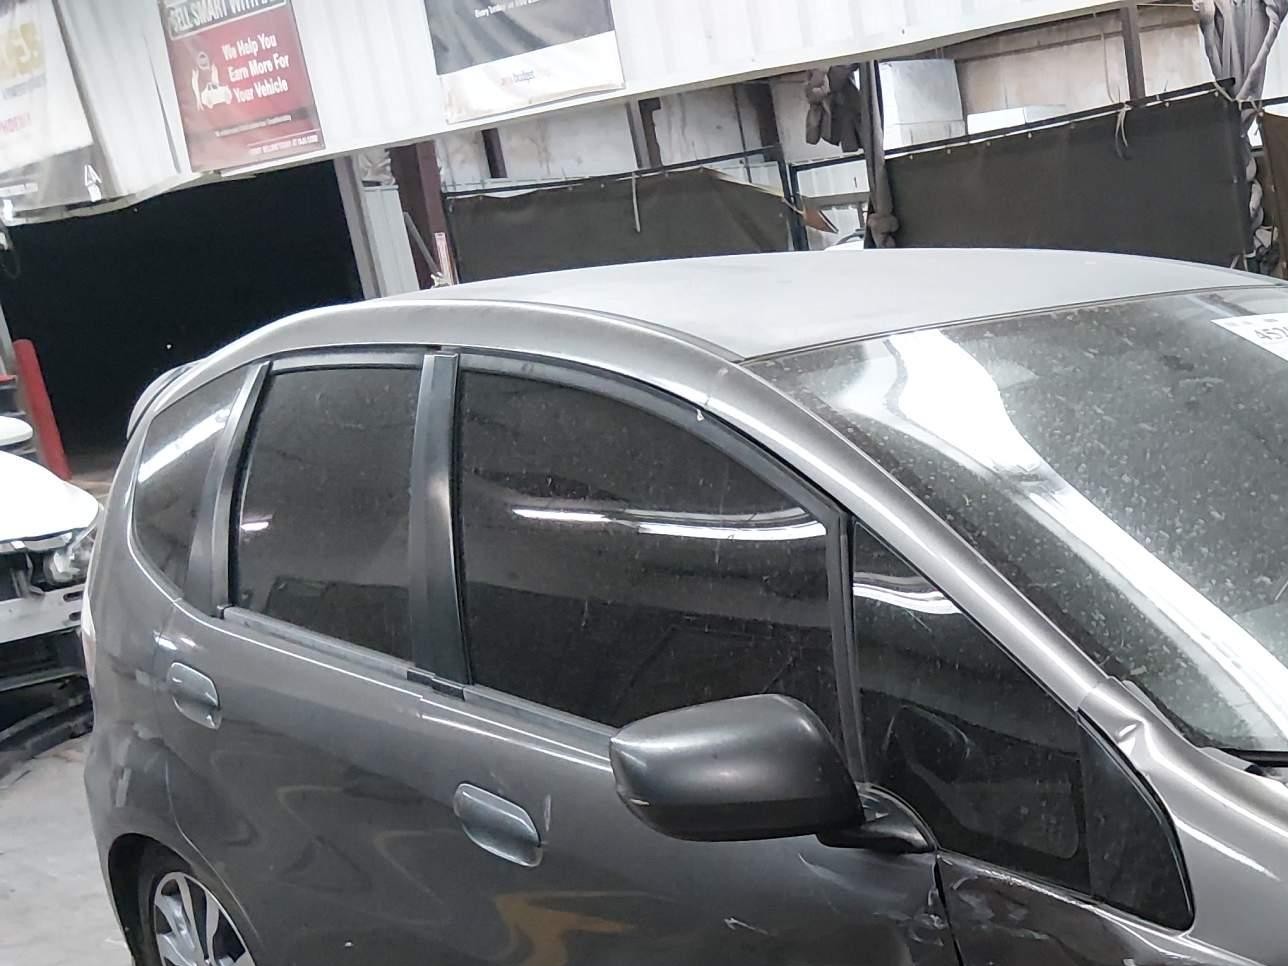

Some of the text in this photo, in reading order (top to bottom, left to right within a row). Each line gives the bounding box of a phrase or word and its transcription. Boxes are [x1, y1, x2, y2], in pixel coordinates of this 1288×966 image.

[222, 33, 277, 61] We Help You
[228, 53, 289, 82] Earn More For
[233, 76, 288, 103] Your Vehicle
